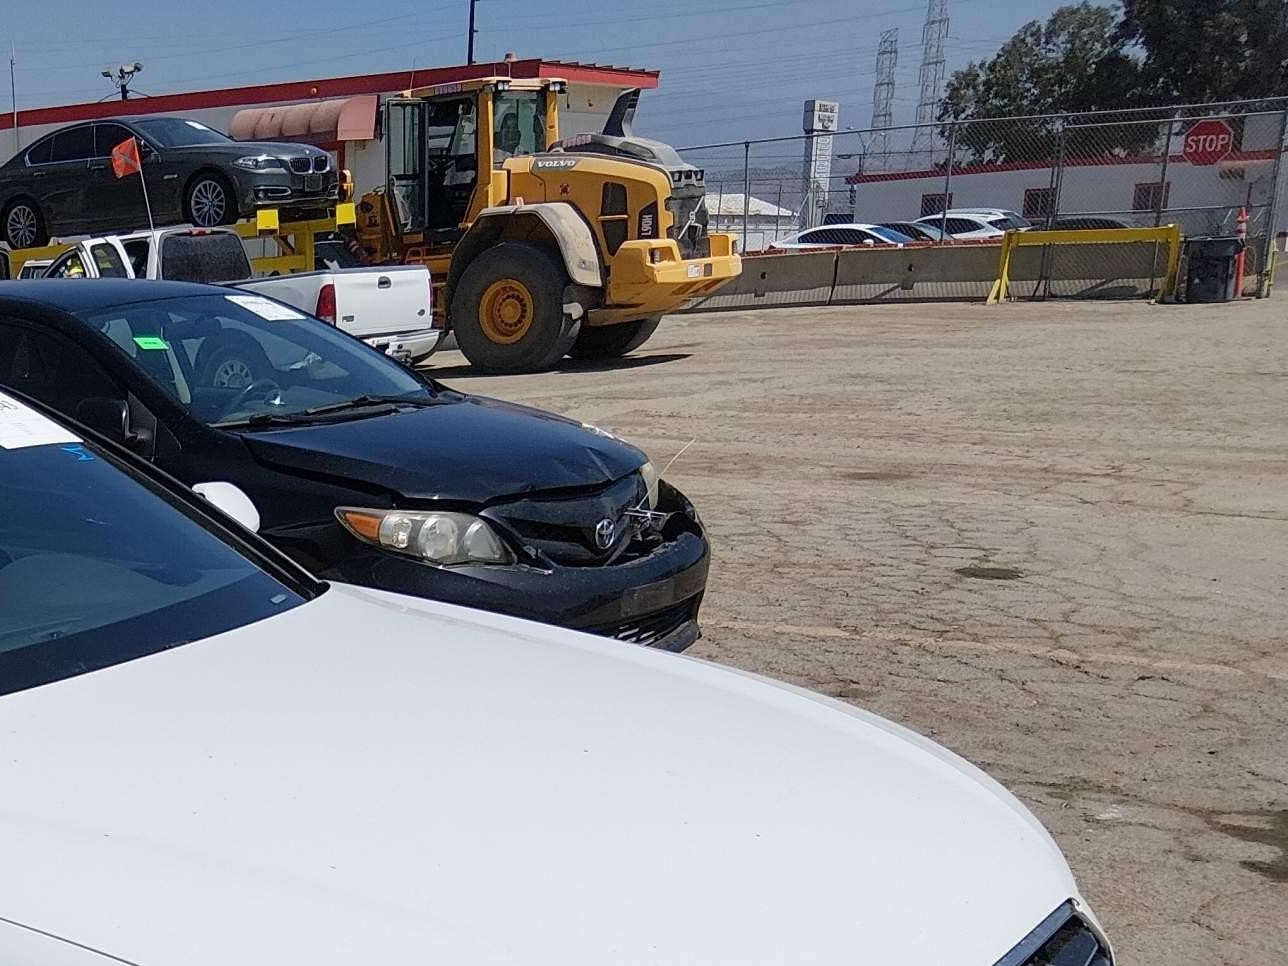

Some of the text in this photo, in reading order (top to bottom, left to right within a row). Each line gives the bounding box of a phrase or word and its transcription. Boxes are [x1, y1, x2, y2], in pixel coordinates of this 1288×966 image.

[1186, 135, 1229, 152] STOP
[537, 160, 576, 168] VOLVO
[641, 214, 653, 235] L90H
